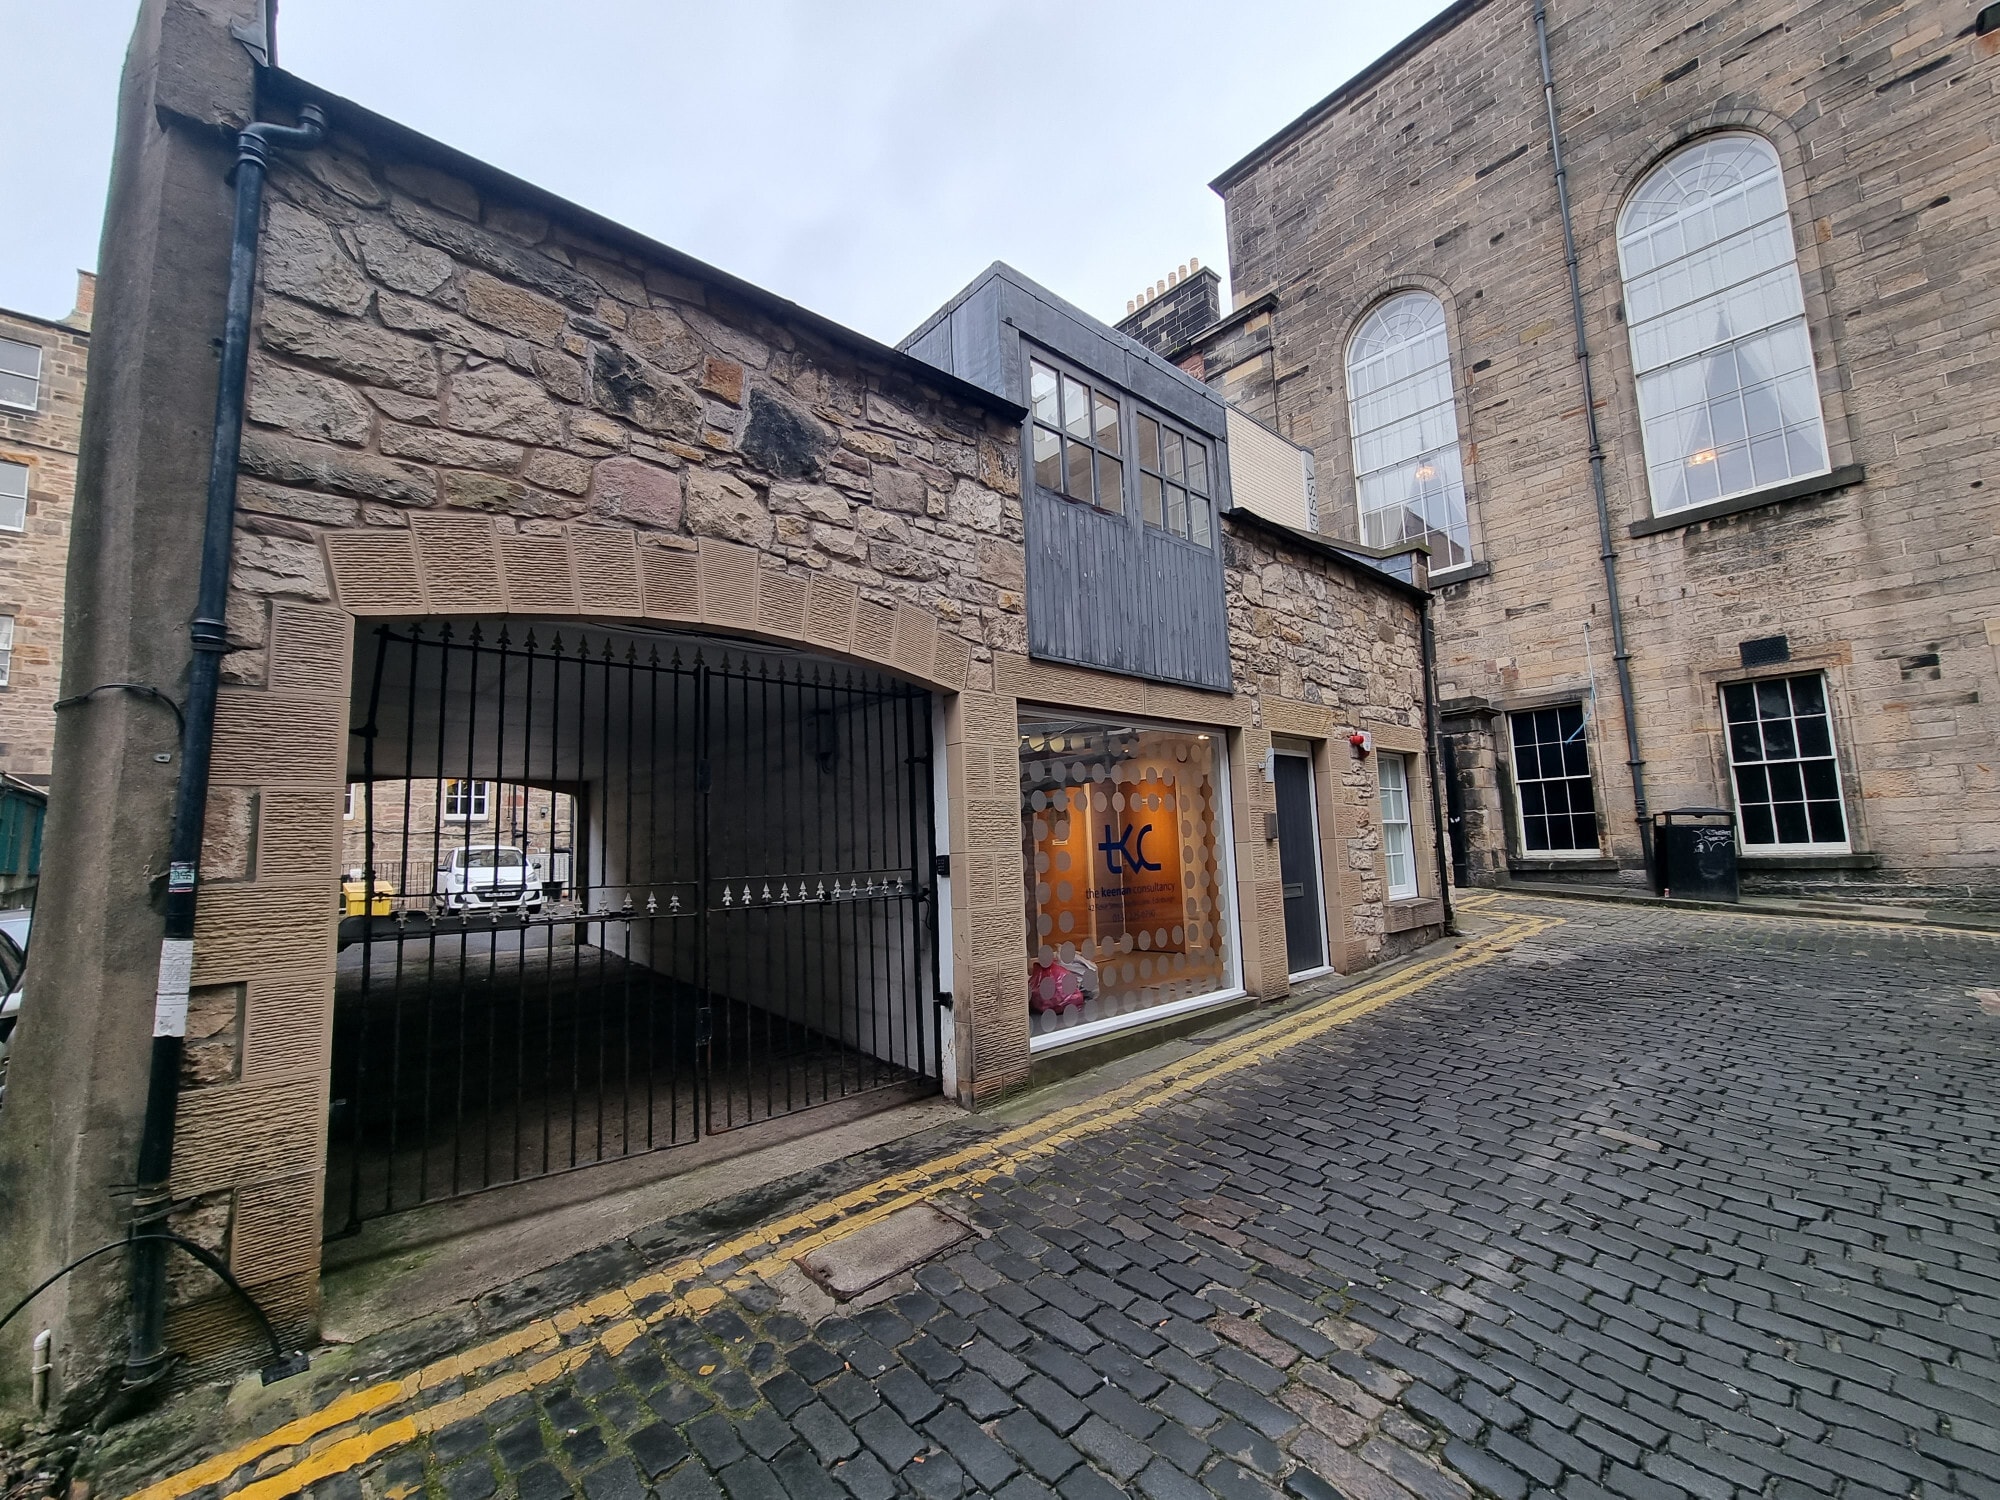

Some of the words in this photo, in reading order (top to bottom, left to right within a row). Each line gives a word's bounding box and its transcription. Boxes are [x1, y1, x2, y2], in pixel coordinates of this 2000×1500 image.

[1086, 887, 1100, 900] the
[1101, 886, 1132, 898] keenan
[1133, 882, 1176, 894] consultancy
